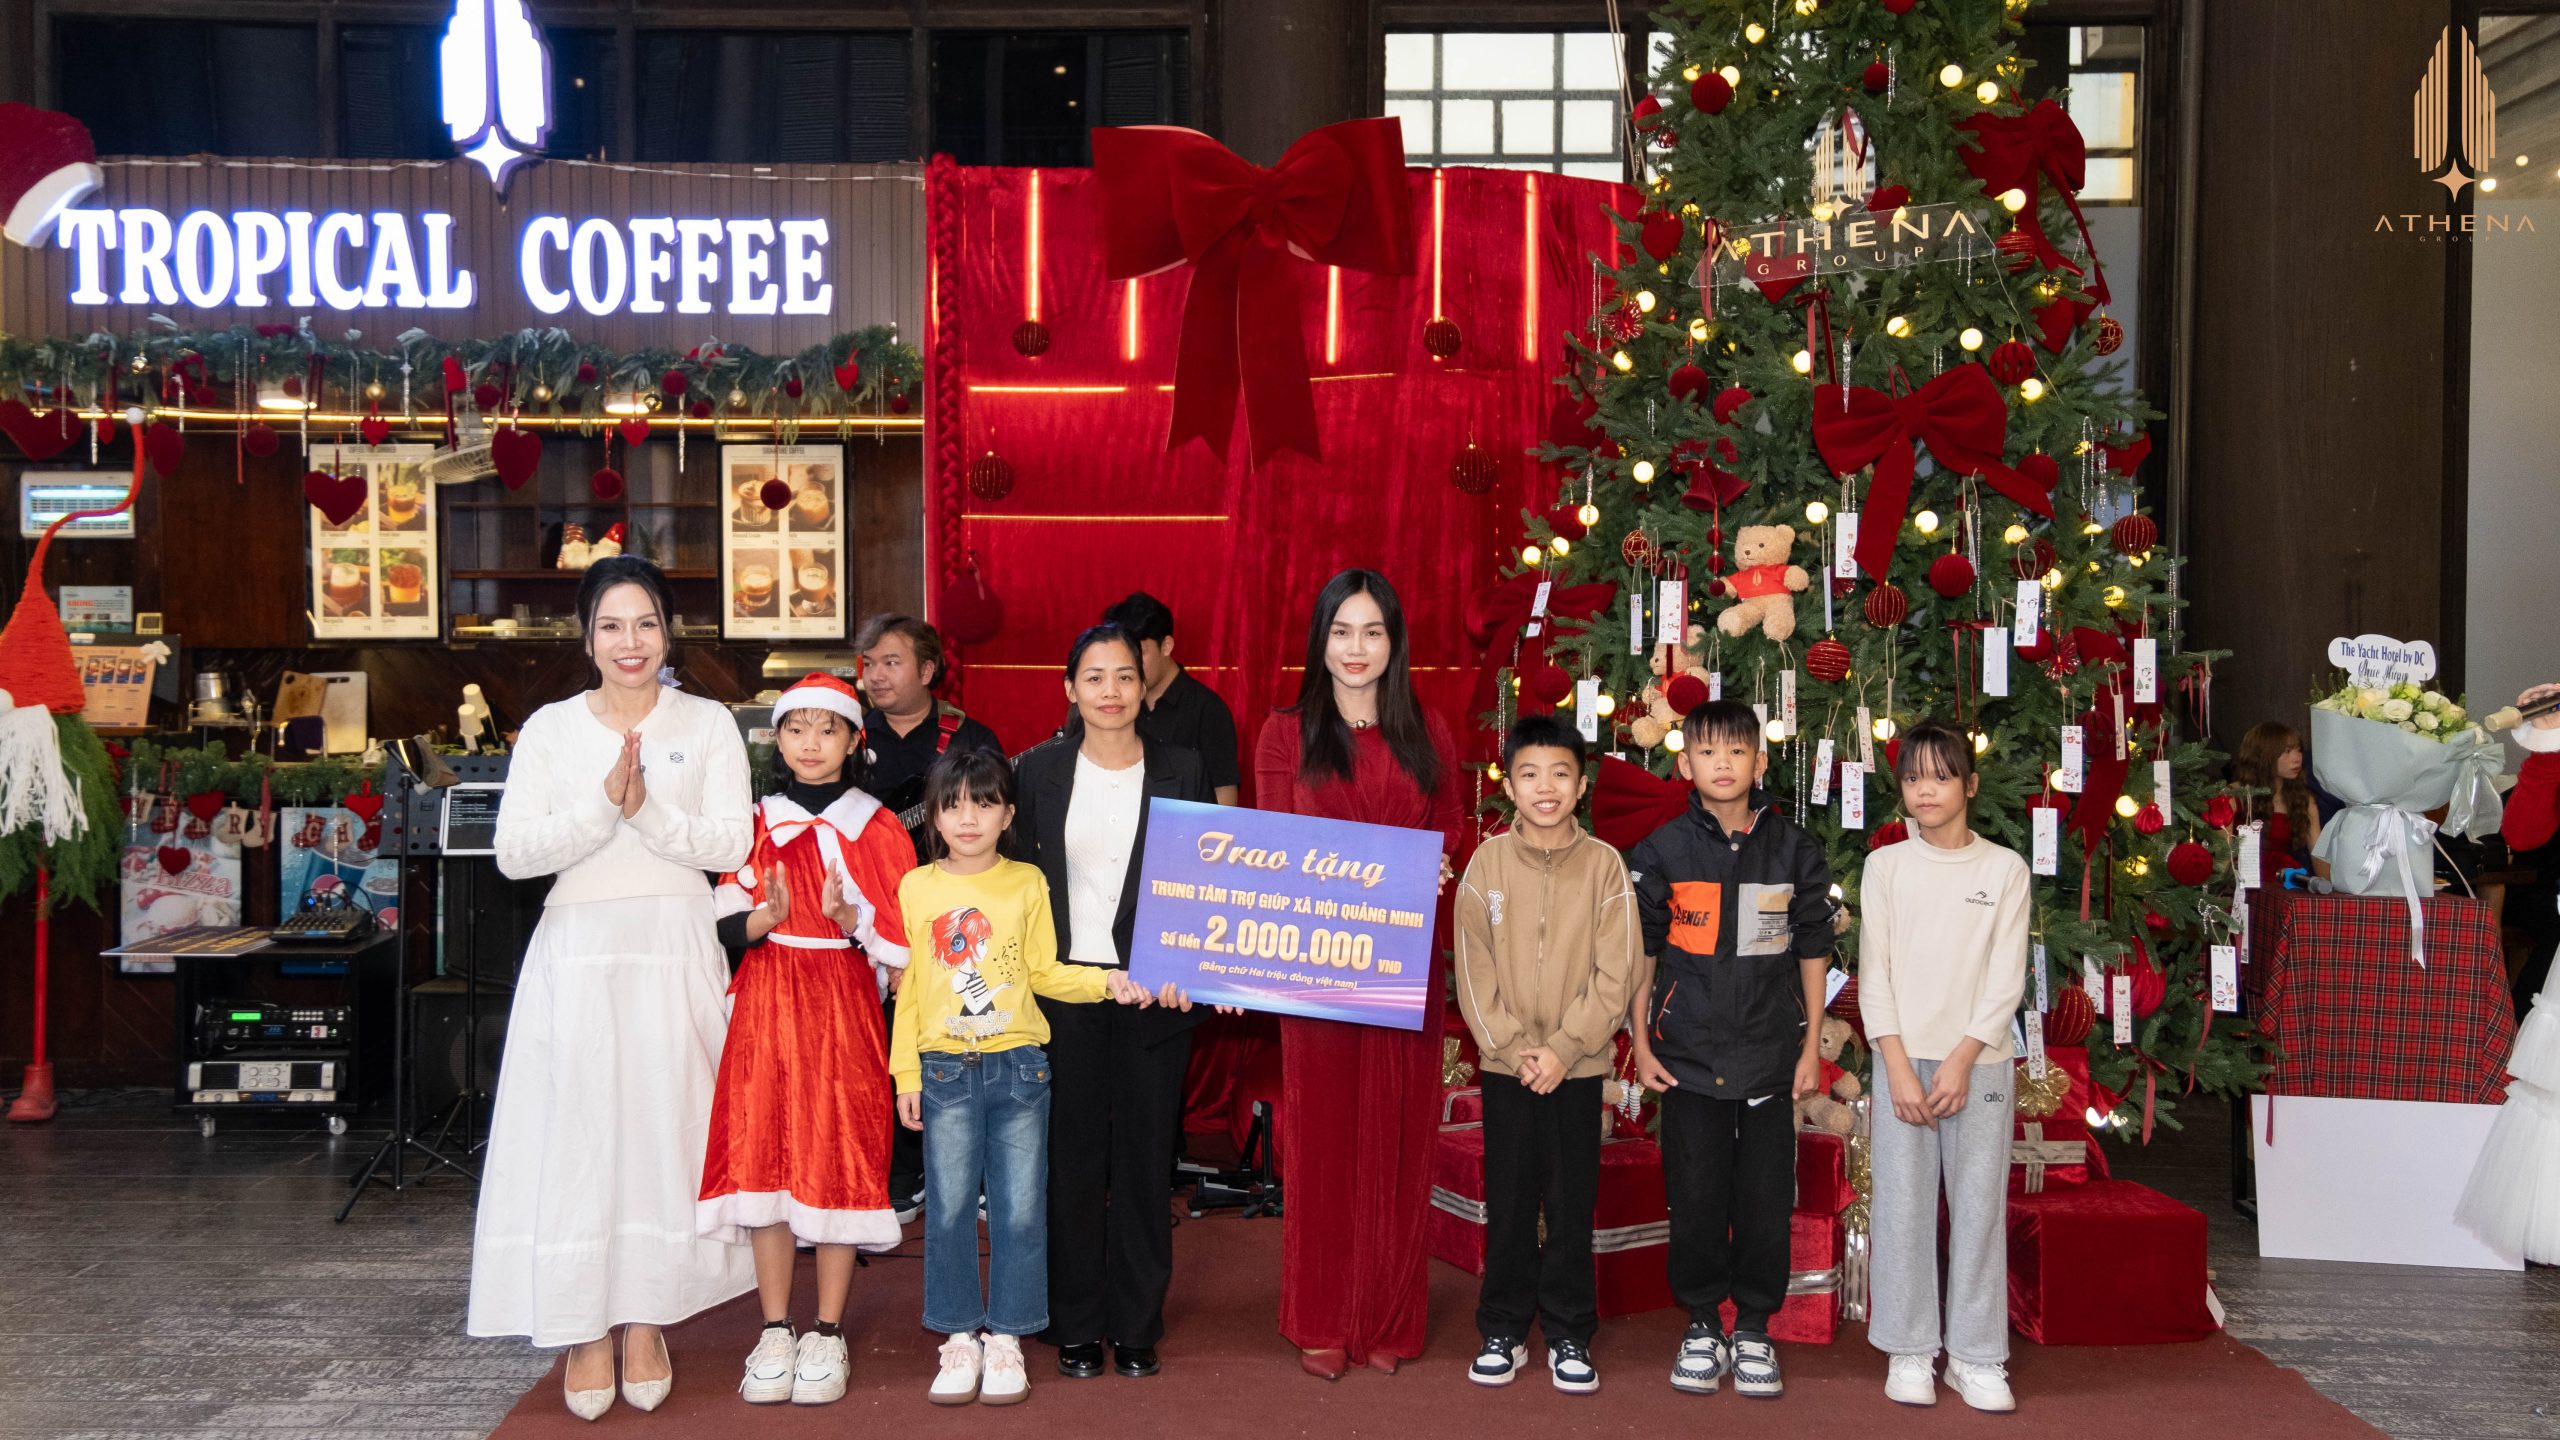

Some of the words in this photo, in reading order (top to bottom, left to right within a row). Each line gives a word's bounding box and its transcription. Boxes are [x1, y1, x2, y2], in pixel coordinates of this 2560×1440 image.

[58, 208, 474, 311] TROPICAL
[520, 215, 835, 316] COFFEE
[1711, 209, 1976, 263] ATHENA
[1756, 245, 1925, 276] GROUP
[2341, 641, 2355, 657] The
[2357, 643, 2379, 659] Yacht
[2381, 645, 2402, 662] Hotel
[2403, 648, 2412, 667] by
[2414, 650, 2425, 666] DC
[1197, 830, 1291, 870] Trao
[1301, 848, 1387, 889] tặng
[1151, 879, 1196, 900] TRUNG
[1198, 882, 1228, 904] TÂM
[1230, 888, 1258, 911] TRỢ
[1259, 891, 1291, 910] GIÚP
[1292, 895, 1313, 914] XÃ
[1314, 898, 1338, 920] HỘI
[1340, 901, 1387, 923] QUẢNG
[1389, 909, 1425, 929] NINH
[1159, 930, 1177, 946] Số
[1178, 932, 1201, 949] tiền
[1203, 914, 1374, 972] 2.000.000
[1228, 965, 1248, 976] chữ
[1248, 966, 1266, 978] Hai
[1266, 969, 1287, 982] triệu
[1289, 971, 1313, 985] đồng
[1334, 979, 1358, 992] nam)
